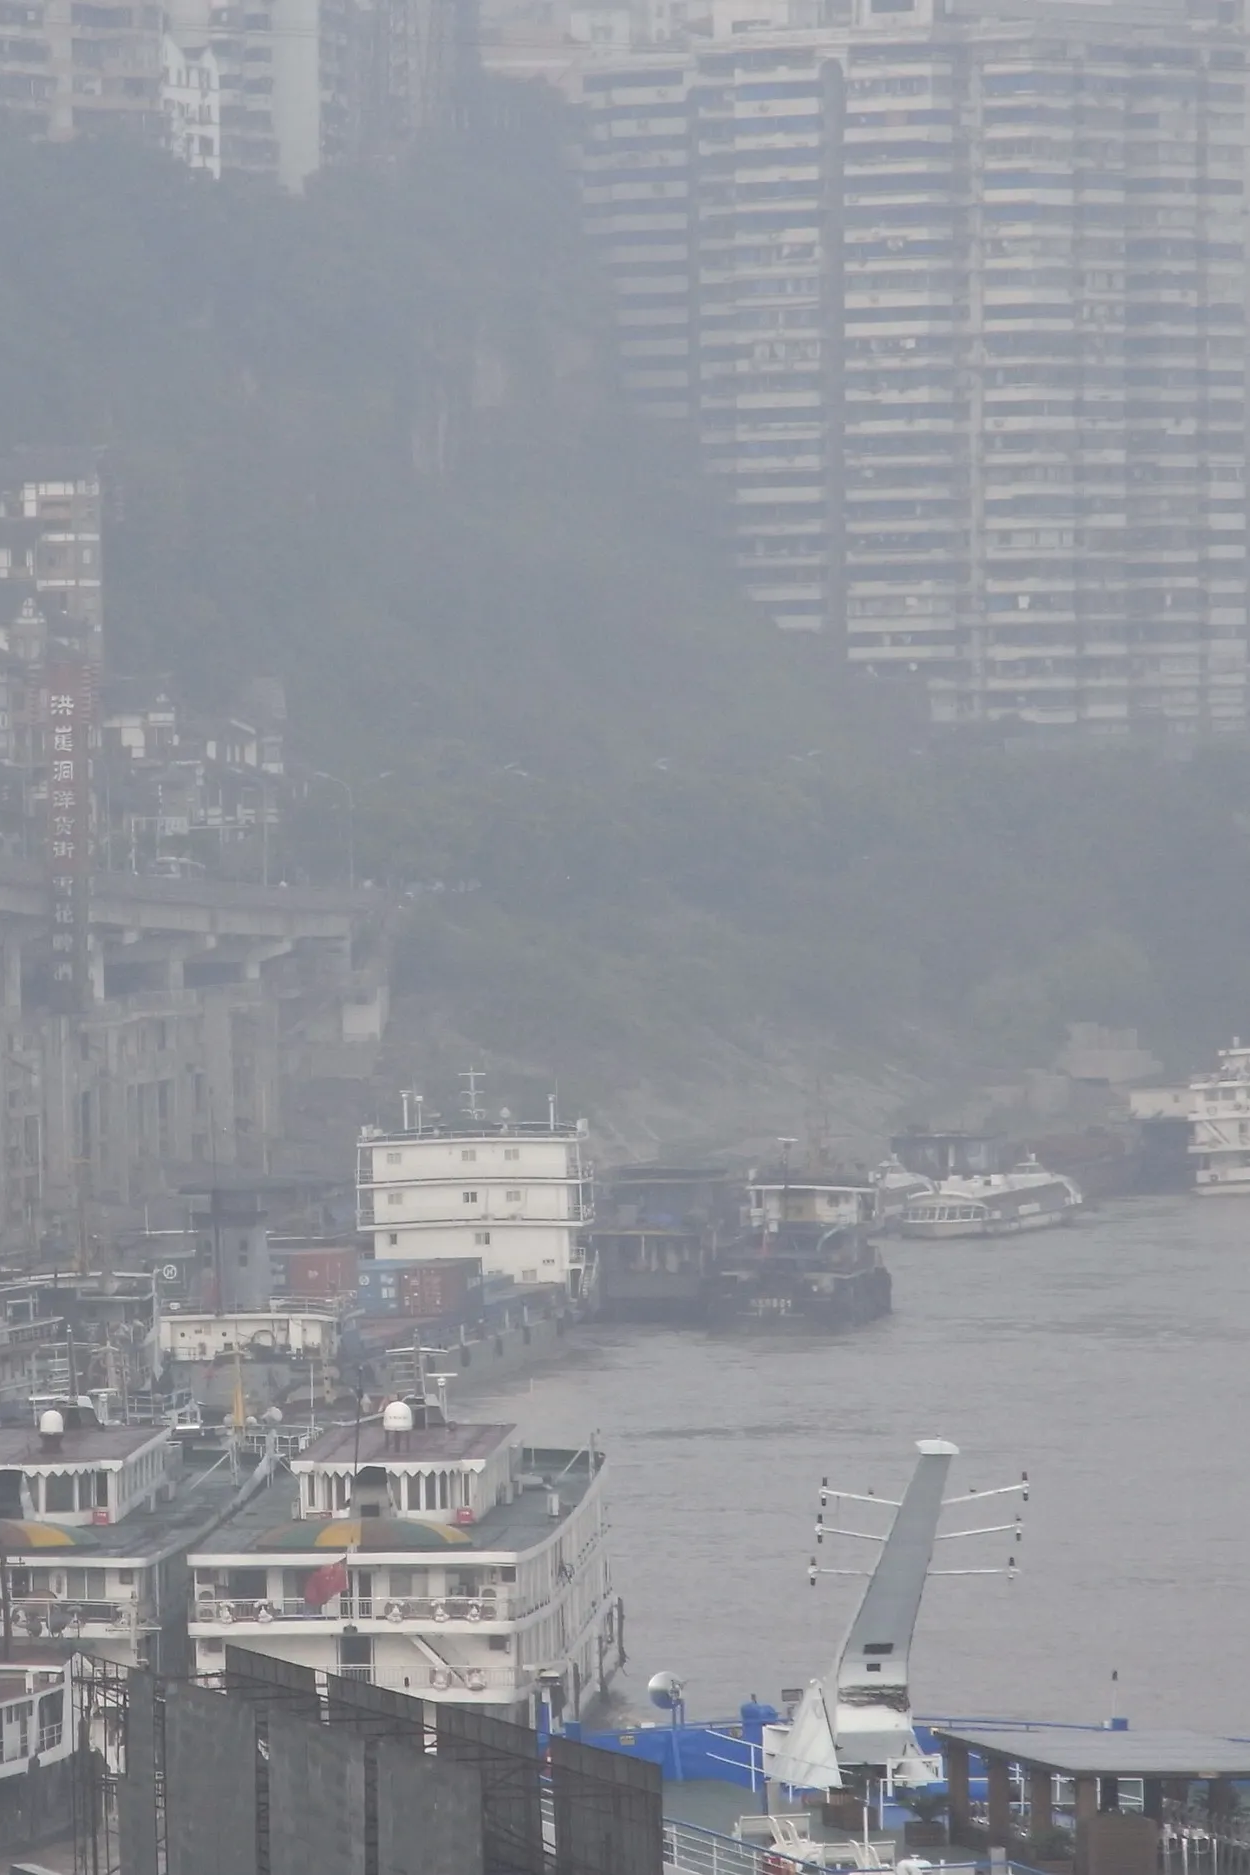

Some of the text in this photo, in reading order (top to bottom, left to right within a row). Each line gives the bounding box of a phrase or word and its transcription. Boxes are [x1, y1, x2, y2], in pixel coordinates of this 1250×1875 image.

[51, 694, 76, 859] 洪崖洞洋货街
